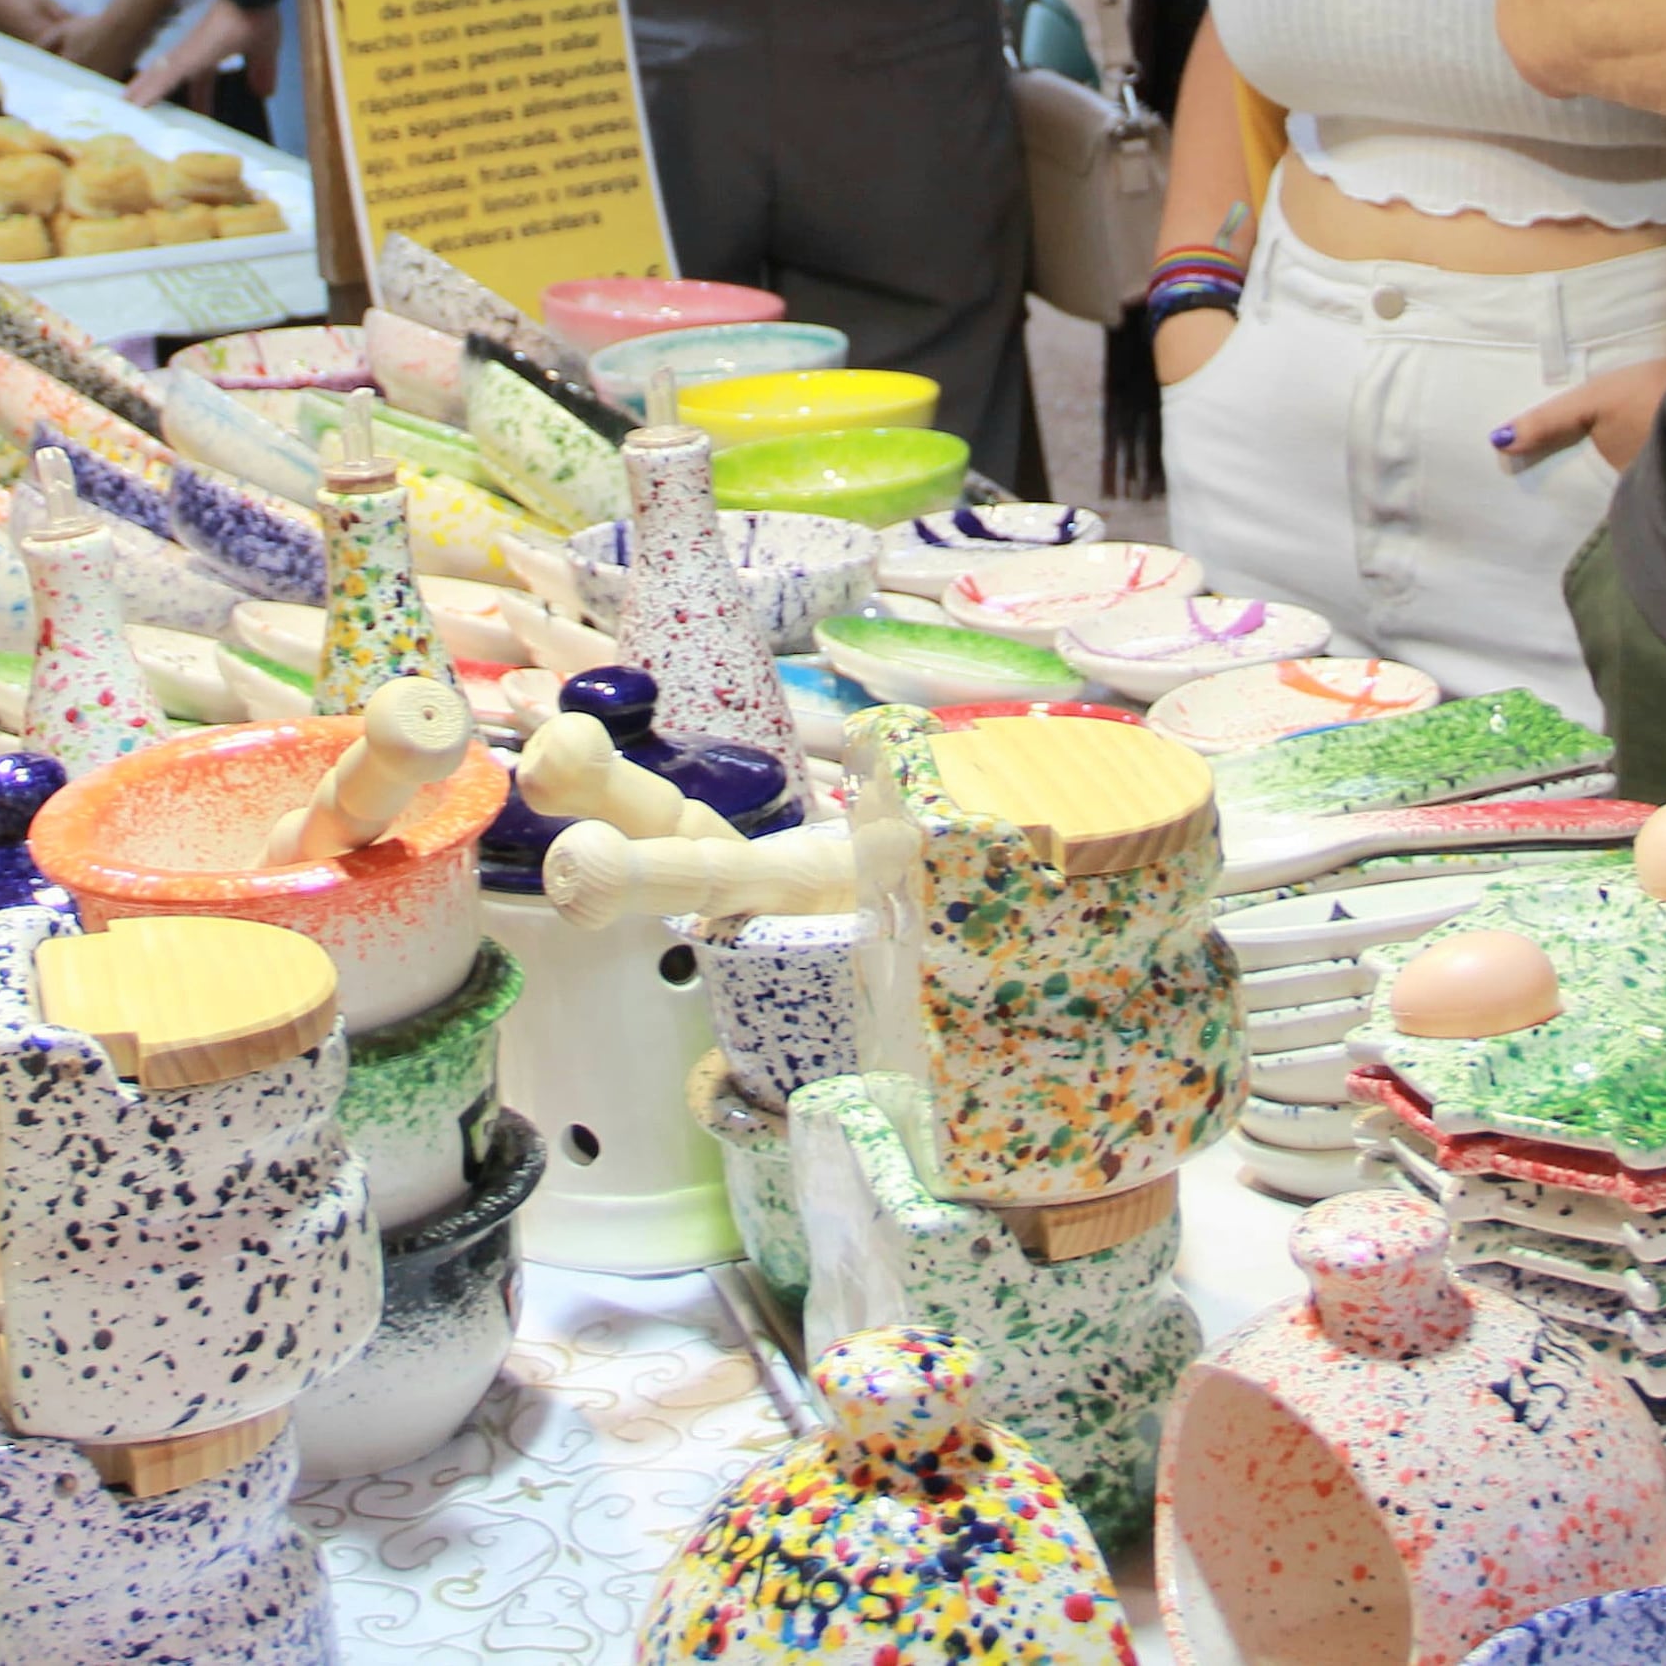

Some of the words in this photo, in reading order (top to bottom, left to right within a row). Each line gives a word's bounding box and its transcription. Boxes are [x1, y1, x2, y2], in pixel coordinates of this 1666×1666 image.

[378, 0, 404, 22] de
[347, 28, 413, 57] hecho
[419, 24, 457, 45] con
[463, 8, 542, 38] esmalte
[375, 61, 416, 87] que
[421, 54, 460, 74] nos
[466, 37, 544, 72] permite
[548, 27, 602, 54] rallar
[356, 76, 489, 120] rápidamente
[495, 74, 521, 93] en
[526, 53, 627, 92] segundos
[367, 121, 400, 144] los
[406, 102, 515, 143] siguientes
[405, 144, 455, 166] nuez
[550, 140, 639, 172] verduras
[564, 172, 640, 203] naranja
